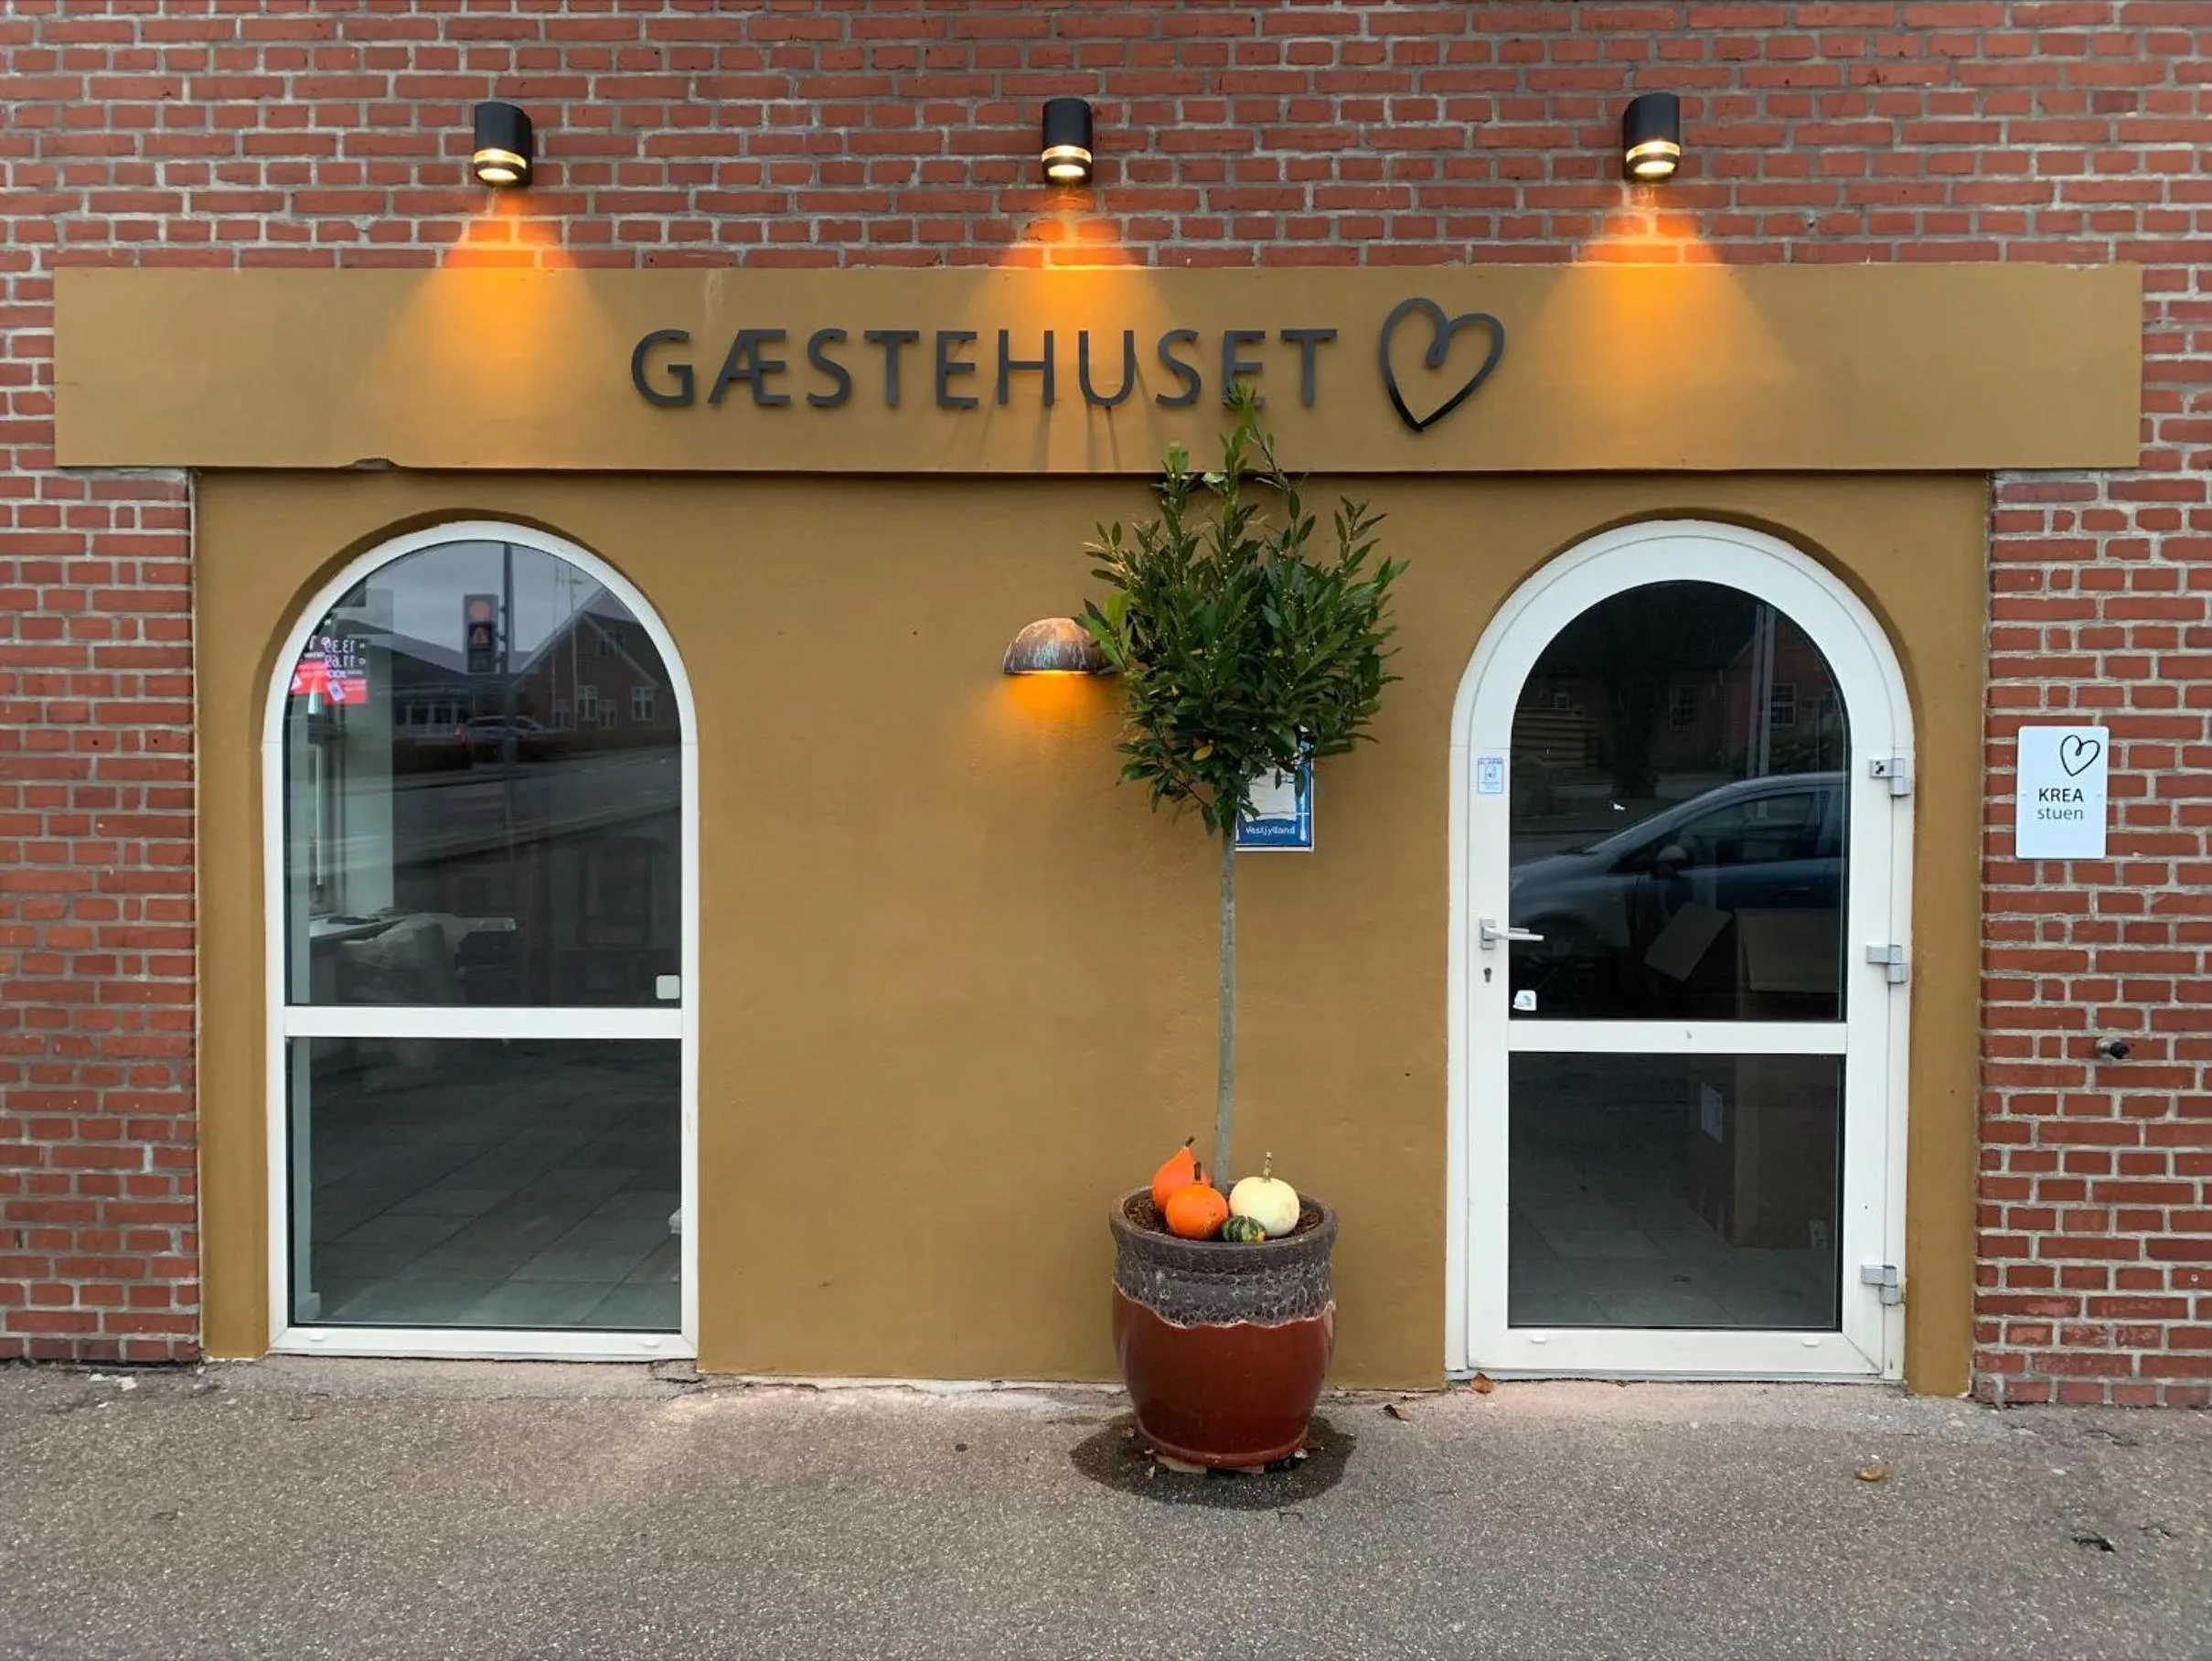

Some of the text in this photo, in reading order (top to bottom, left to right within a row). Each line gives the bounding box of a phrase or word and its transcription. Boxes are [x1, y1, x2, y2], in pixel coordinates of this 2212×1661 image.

[630, 328, 1337, 409] GÆSTEHUSET
[2038, 788, 2084, 802] KREA
[2037, 807, 2084, 820] stuen
[1245, 825, 1297, 837] Vestjylland
